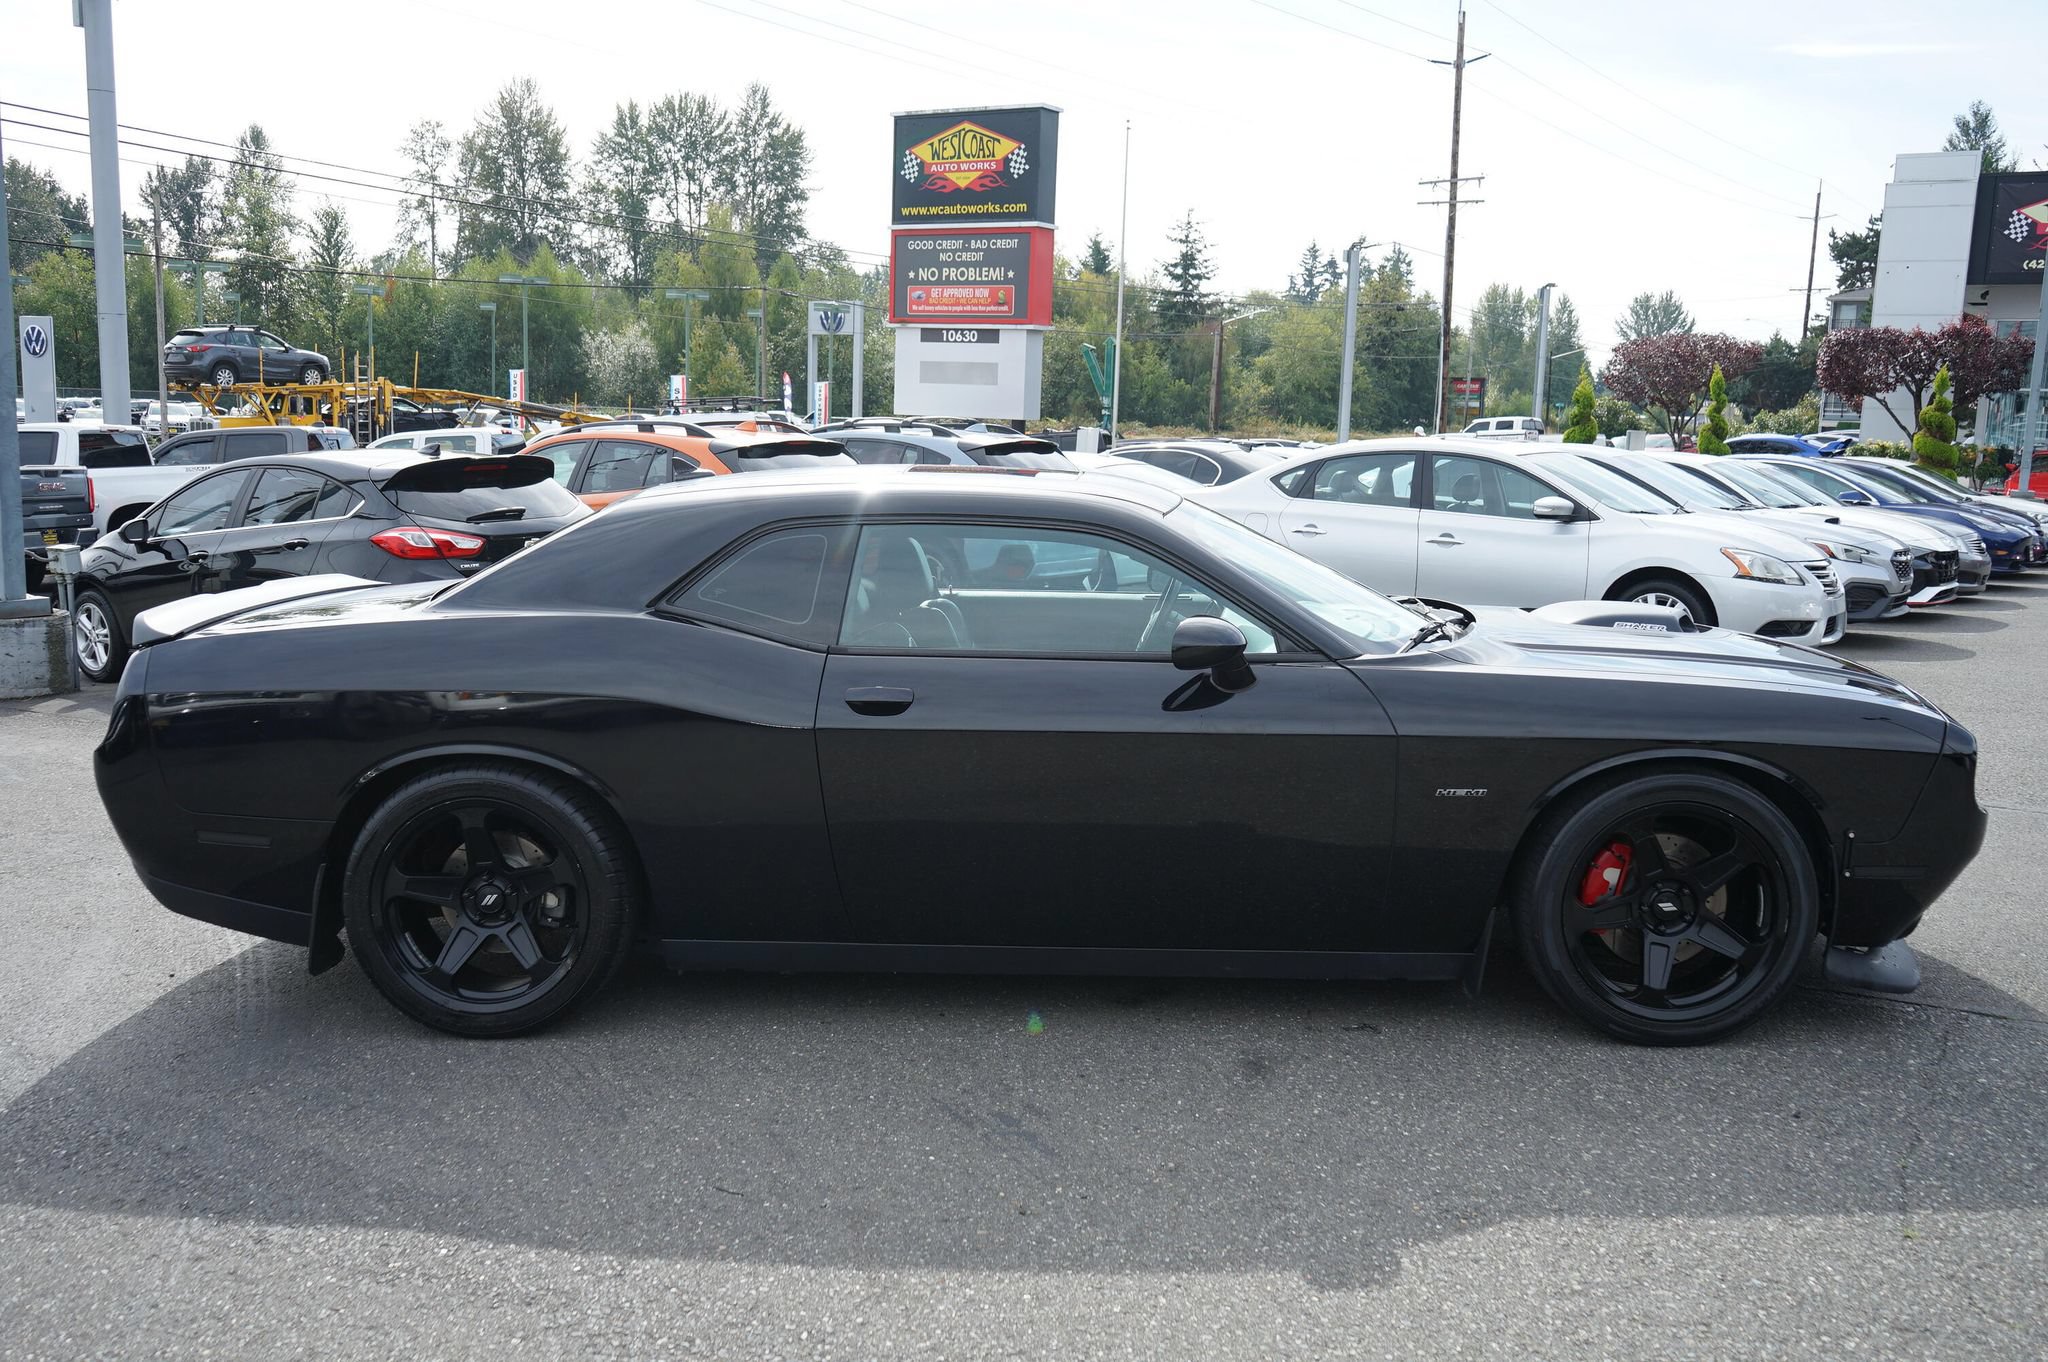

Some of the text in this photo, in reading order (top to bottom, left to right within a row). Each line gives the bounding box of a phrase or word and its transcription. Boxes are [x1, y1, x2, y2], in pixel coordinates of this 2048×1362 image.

[931, 161, 997, 172] AUTO WORKS
[901, 202, 1027, 216] www.wcautoworks.com
[907, 240, 934, 250] GOOD
[935, 240, 963, 249] CREDIT
[970, 239, 988, 249] BAD
[990, 239, 1019, 249] CREDIT
[939, 252, 984, 262] NO CREDIT
[2022, 260, 2045, 270] (42
[918, 266, 1005, 281] NO PROBLEM!
[931, 288, 989, 298] GET APPROVED NOW
[942, 330, 978, 342] 10630
[1614, 621, 1667, 632] SHAKER
